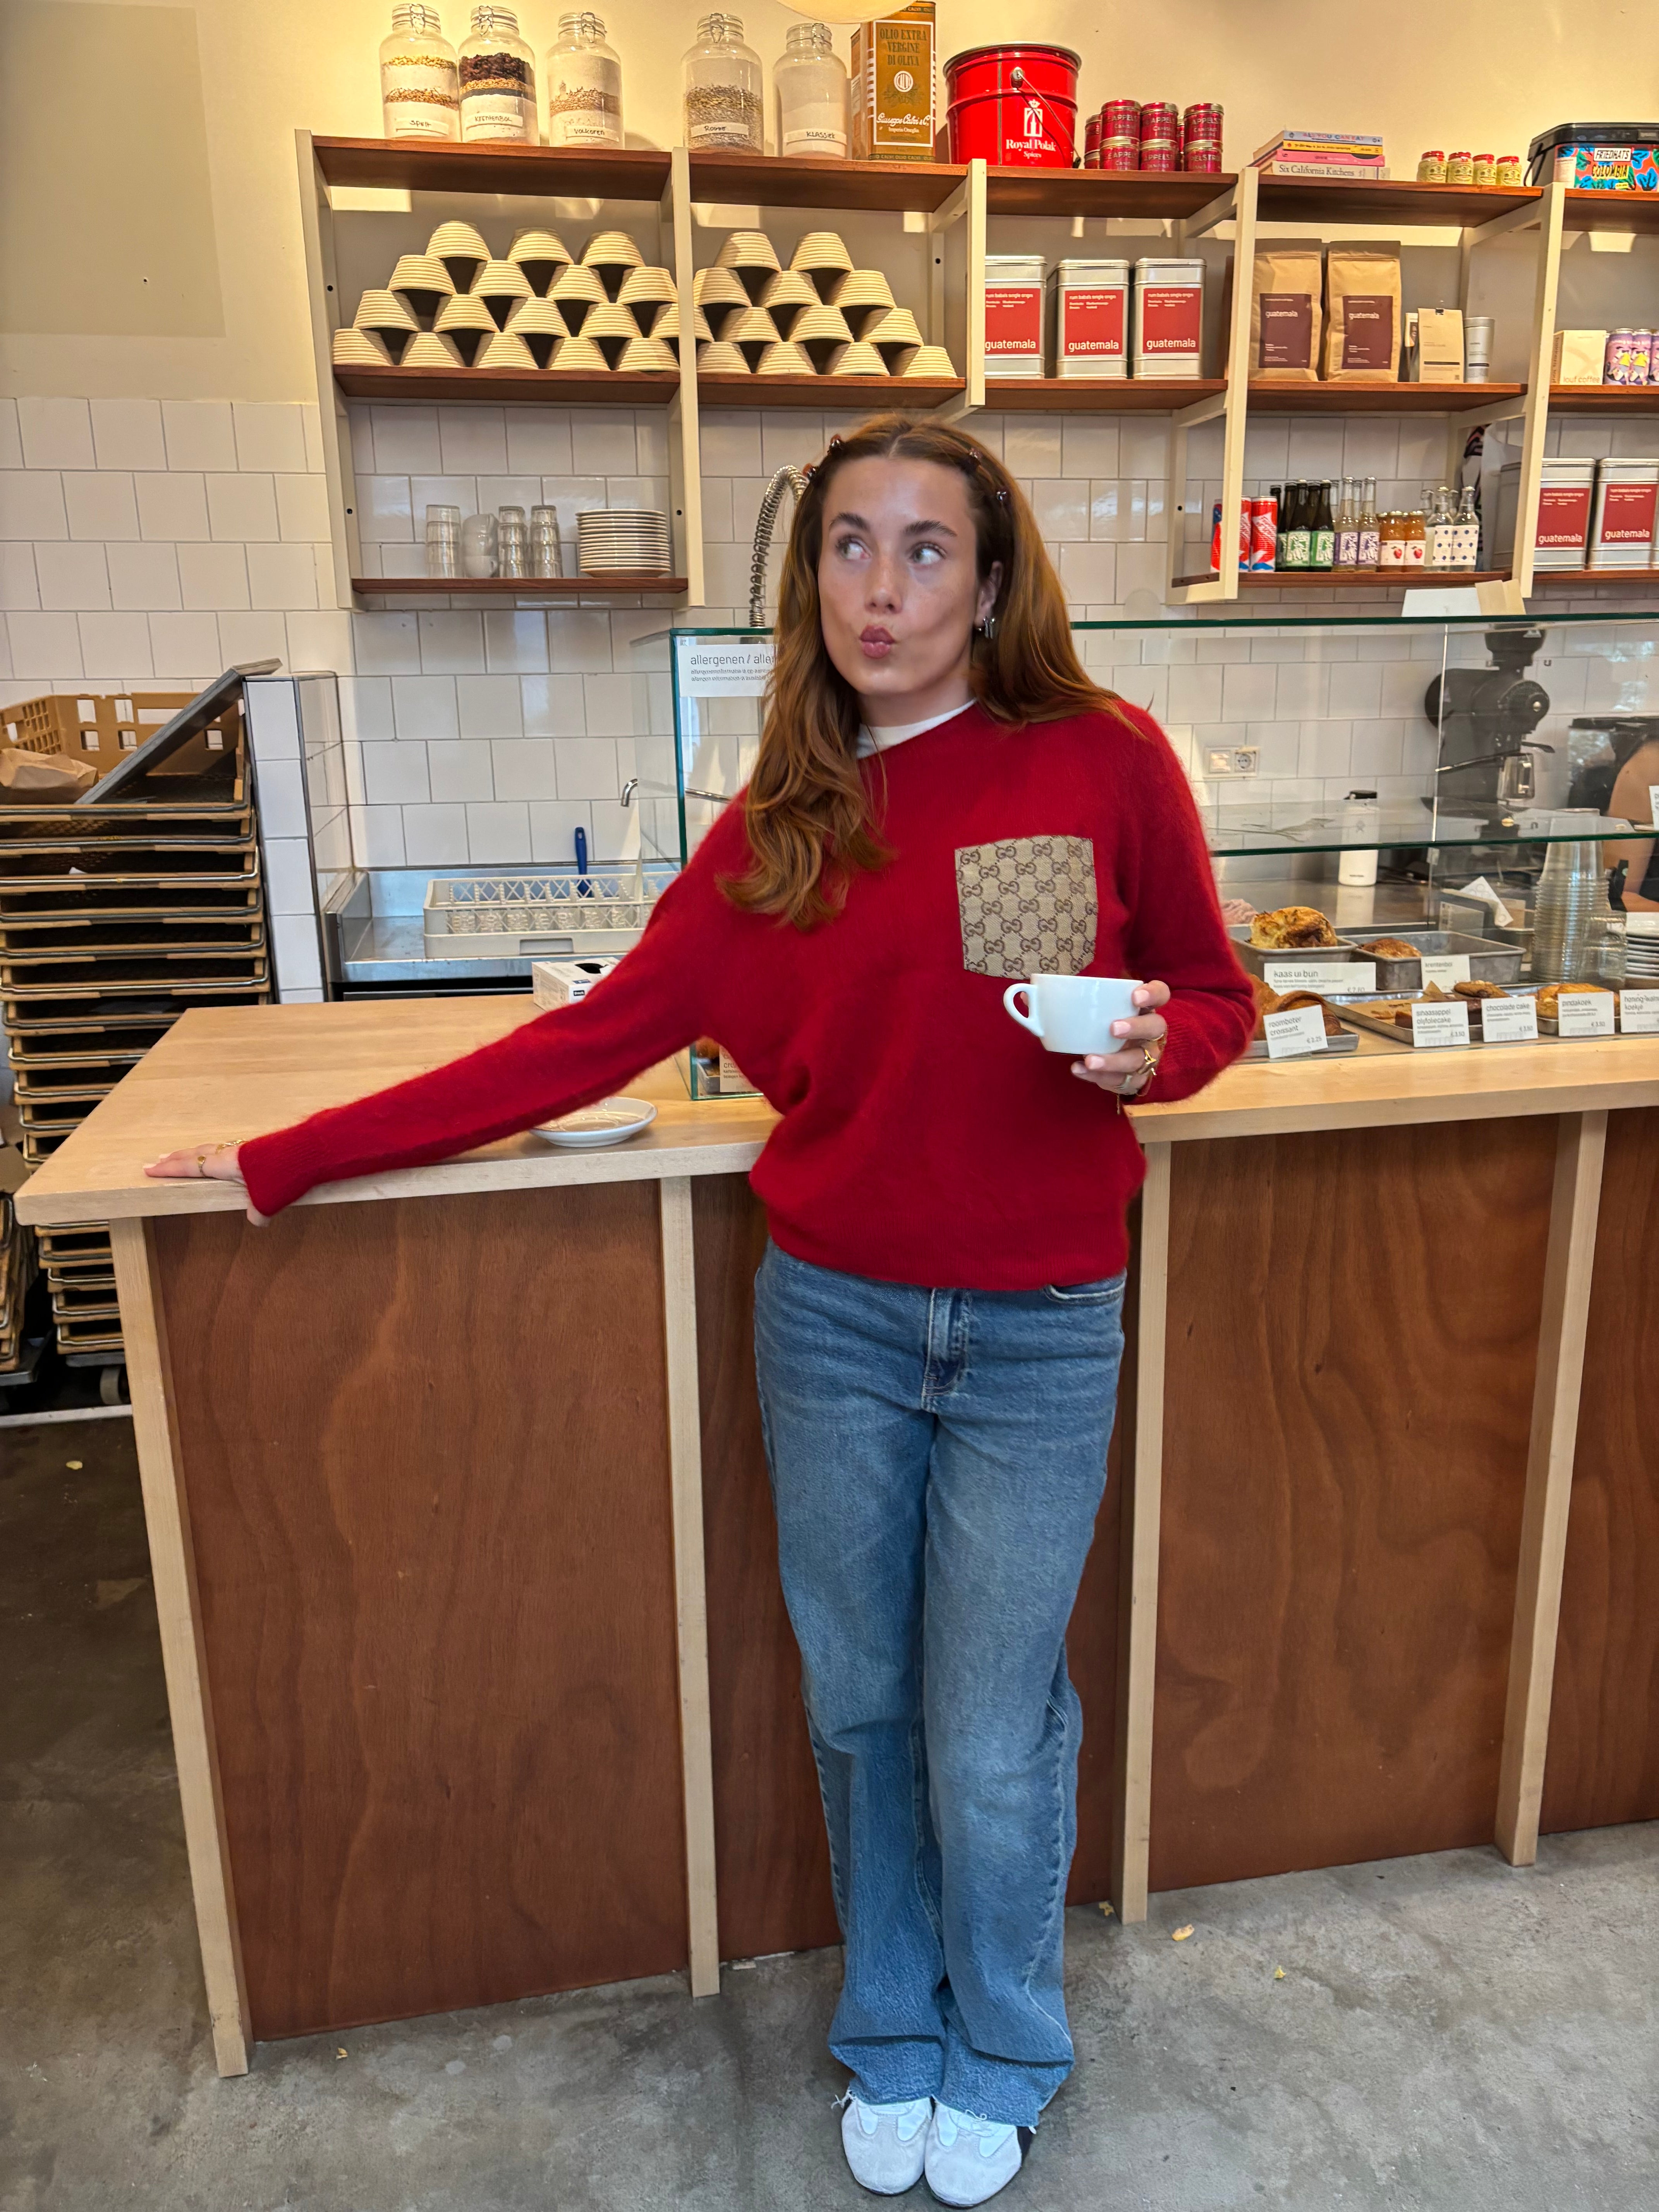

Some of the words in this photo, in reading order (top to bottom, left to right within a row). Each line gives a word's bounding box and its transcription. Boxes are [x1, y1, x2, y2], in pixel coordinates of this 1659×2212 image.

[880, 28, 899, 39] OLIO
[901, 29, 927, 41] EXTRA
[887, 42, 920, 53] VERGINE
[887, 55, 895, 65] DI
[898, 55, 919, 66] OLIVA
[1006, 139, 1032, 151] Royal
[1034, 139, 1056, 152] Polak
[1595, 150, 1630, 159] FRIEDHATS
[1279, 165, 1290, 173] Six
[1291, 165, 1325, 175] California
[1326, 167, 1355, 176] Kitchens
[985, 339, 1036, 351] guatemala
[1068, 339, 1119, 352] guatemala
[1146, 338, 1196, 350] guatemala
[1538, 533, 1582, 544] guatemala
[1605, 529, 1650, 540] guatemala
[690, 654, 745, 667] allergenen
